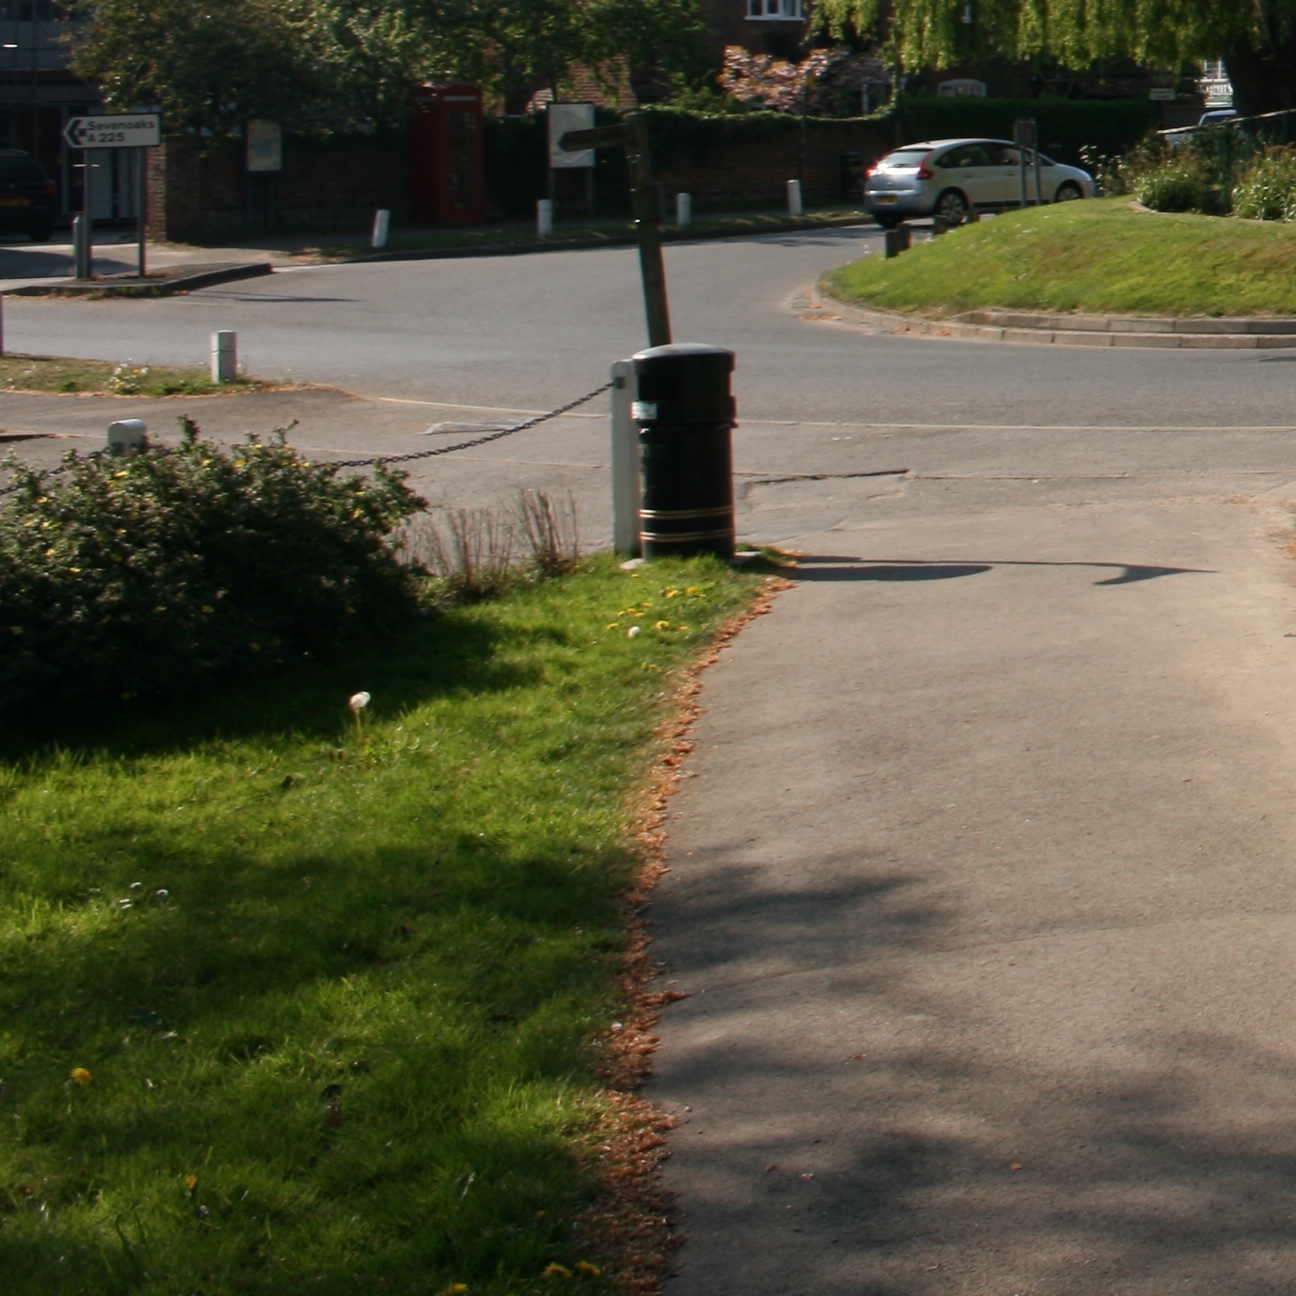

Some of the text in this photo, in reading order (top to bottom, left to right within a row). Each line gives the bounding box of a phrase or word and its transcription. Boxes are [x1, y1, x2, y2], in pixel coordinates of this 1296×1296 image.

[87, 120, 156, 131] Sevenoaks
[88, 132, 125, 143] A 225
